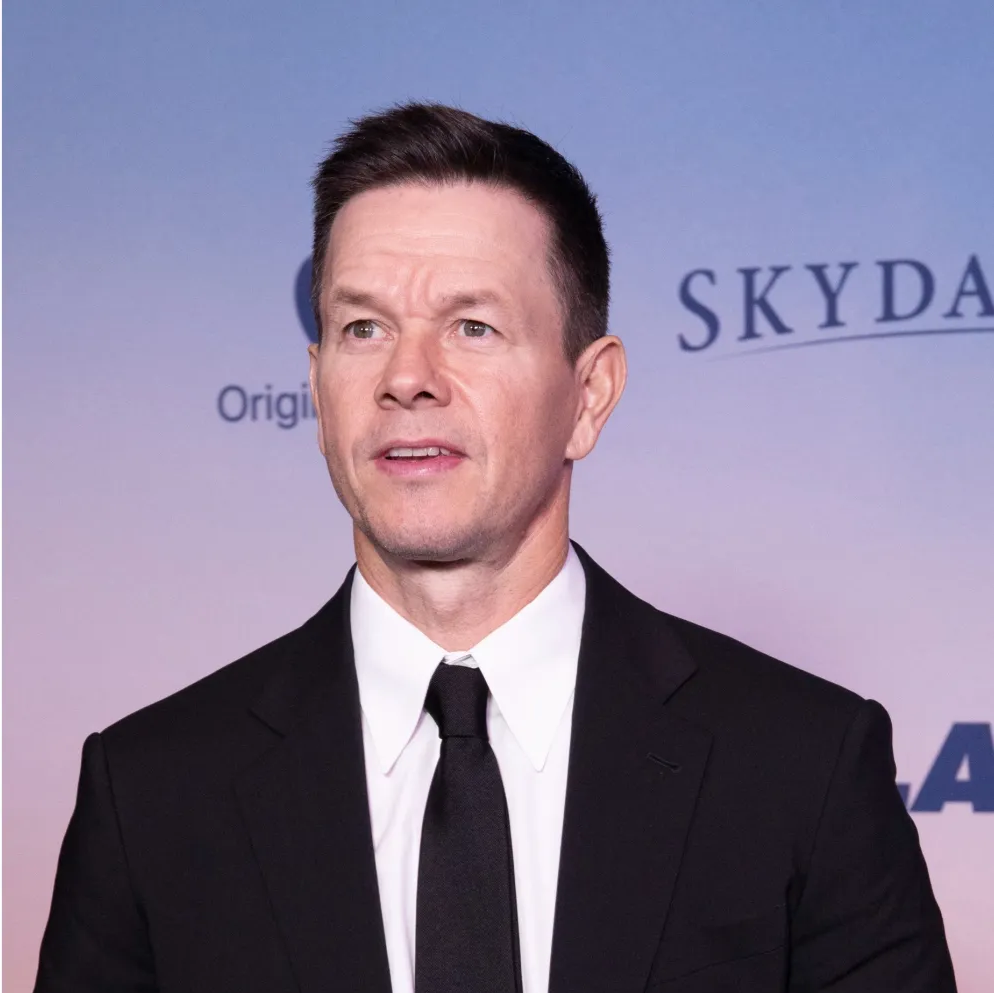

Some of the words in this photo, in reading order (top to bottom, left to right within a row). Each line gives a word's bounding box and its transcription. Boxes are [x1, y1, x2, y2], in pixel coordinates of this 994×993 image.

[677, 252, 994, 353] SKYDA
[217, 382, 317, 430] Origi
[896, 721, 994, 813] A
